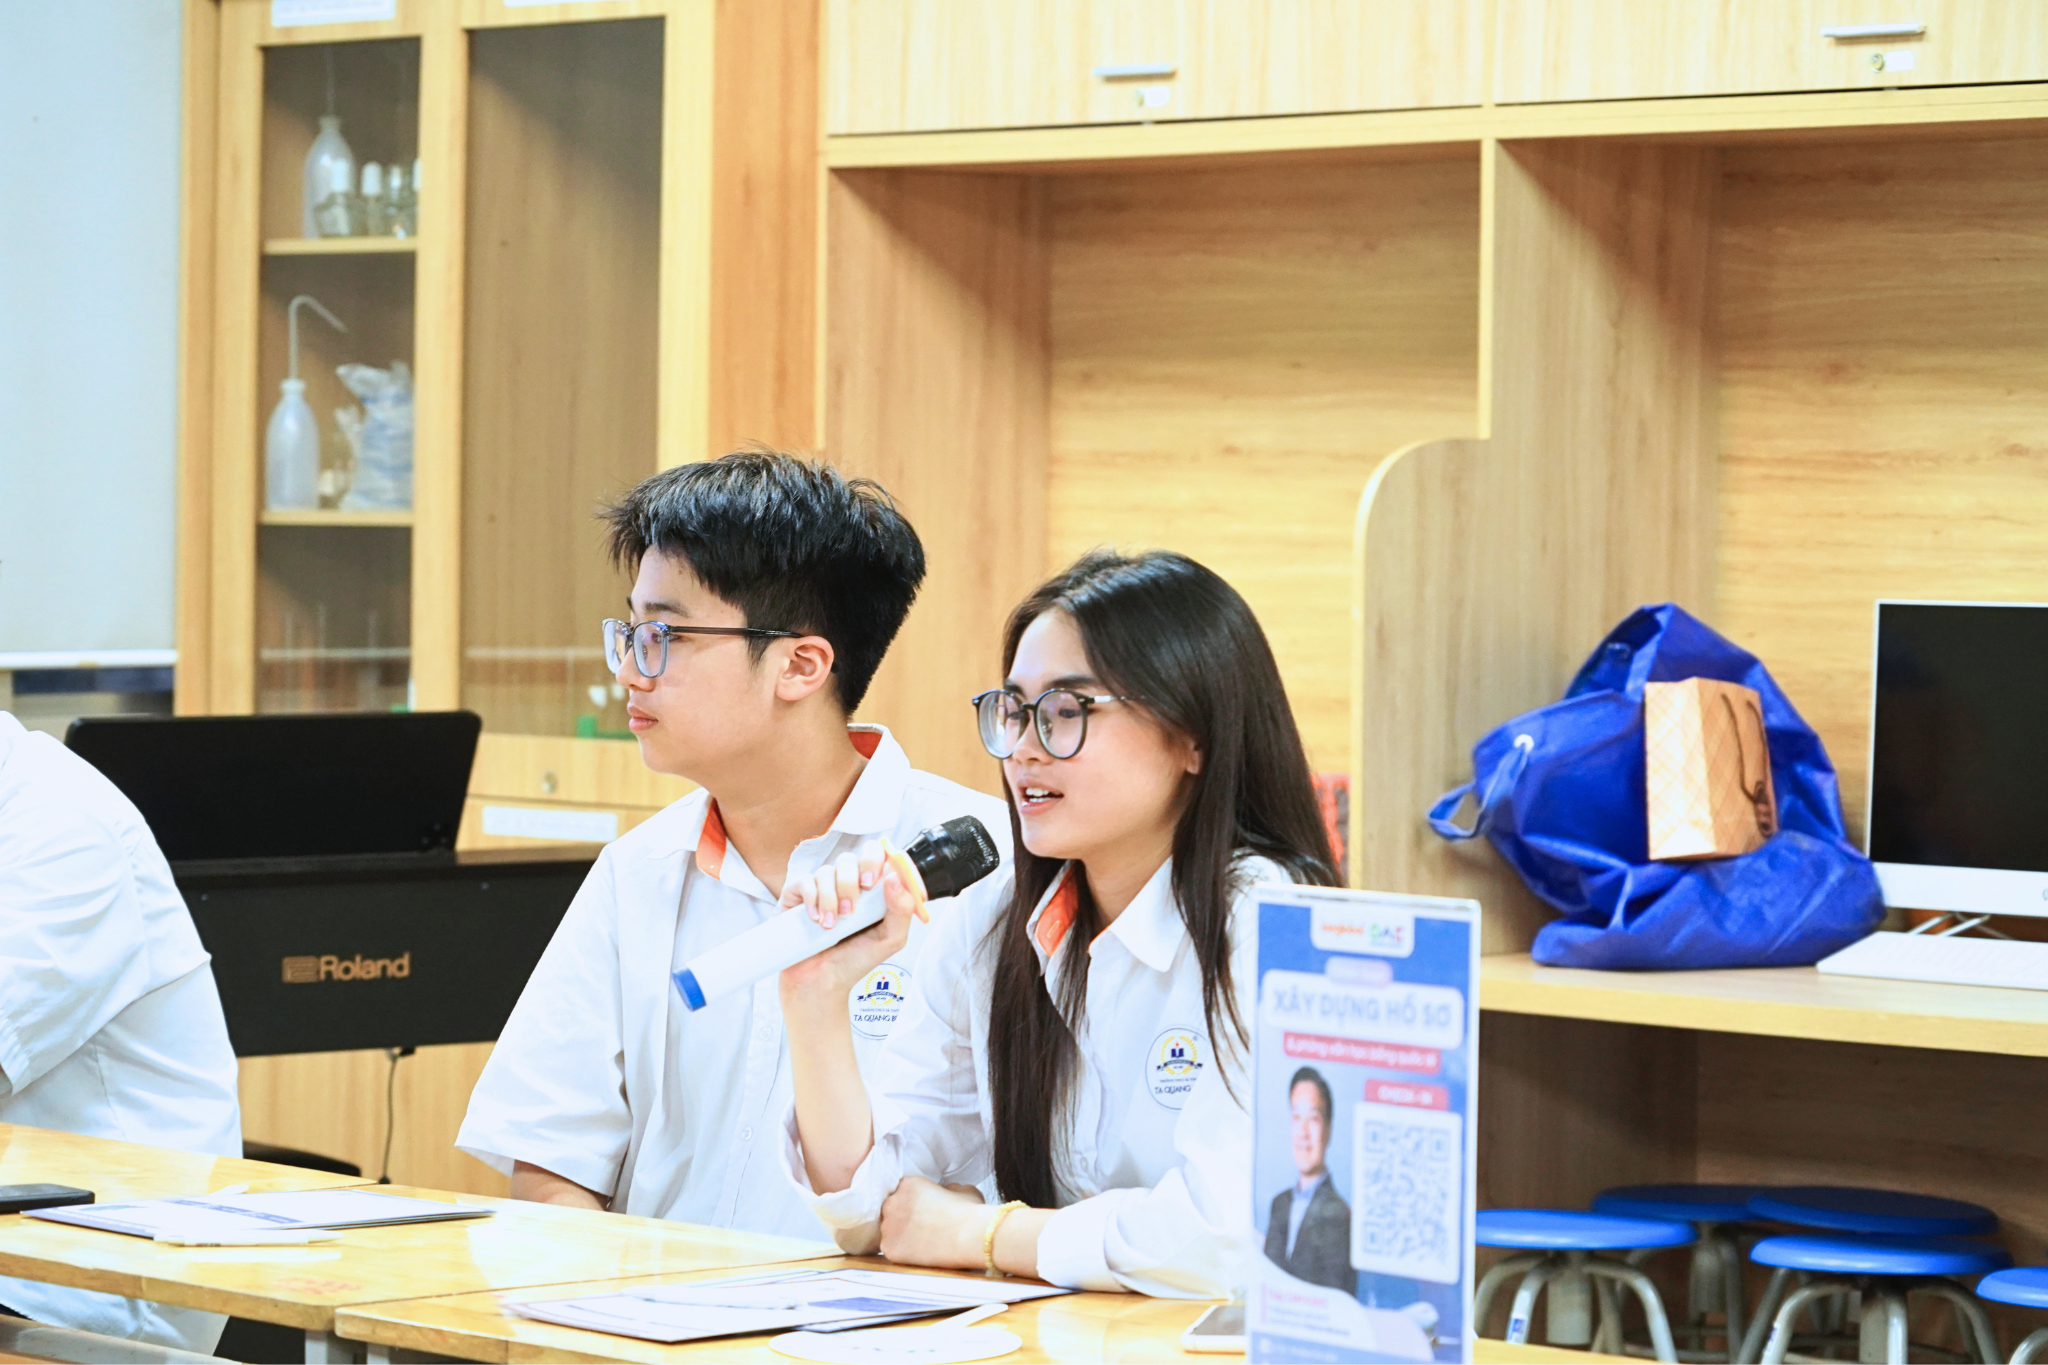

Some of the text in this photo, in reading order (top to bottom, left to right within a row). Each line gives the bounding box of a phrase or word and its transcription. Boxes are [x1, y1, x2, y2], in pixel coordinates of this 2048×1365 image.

[320, 951, 411, 981] Roland
[863, 1014, 891, 1023] QUANG
[1273, 982, 1317, 1014] XÂY
[1320, 991, 1380, 1026] DỰNG
